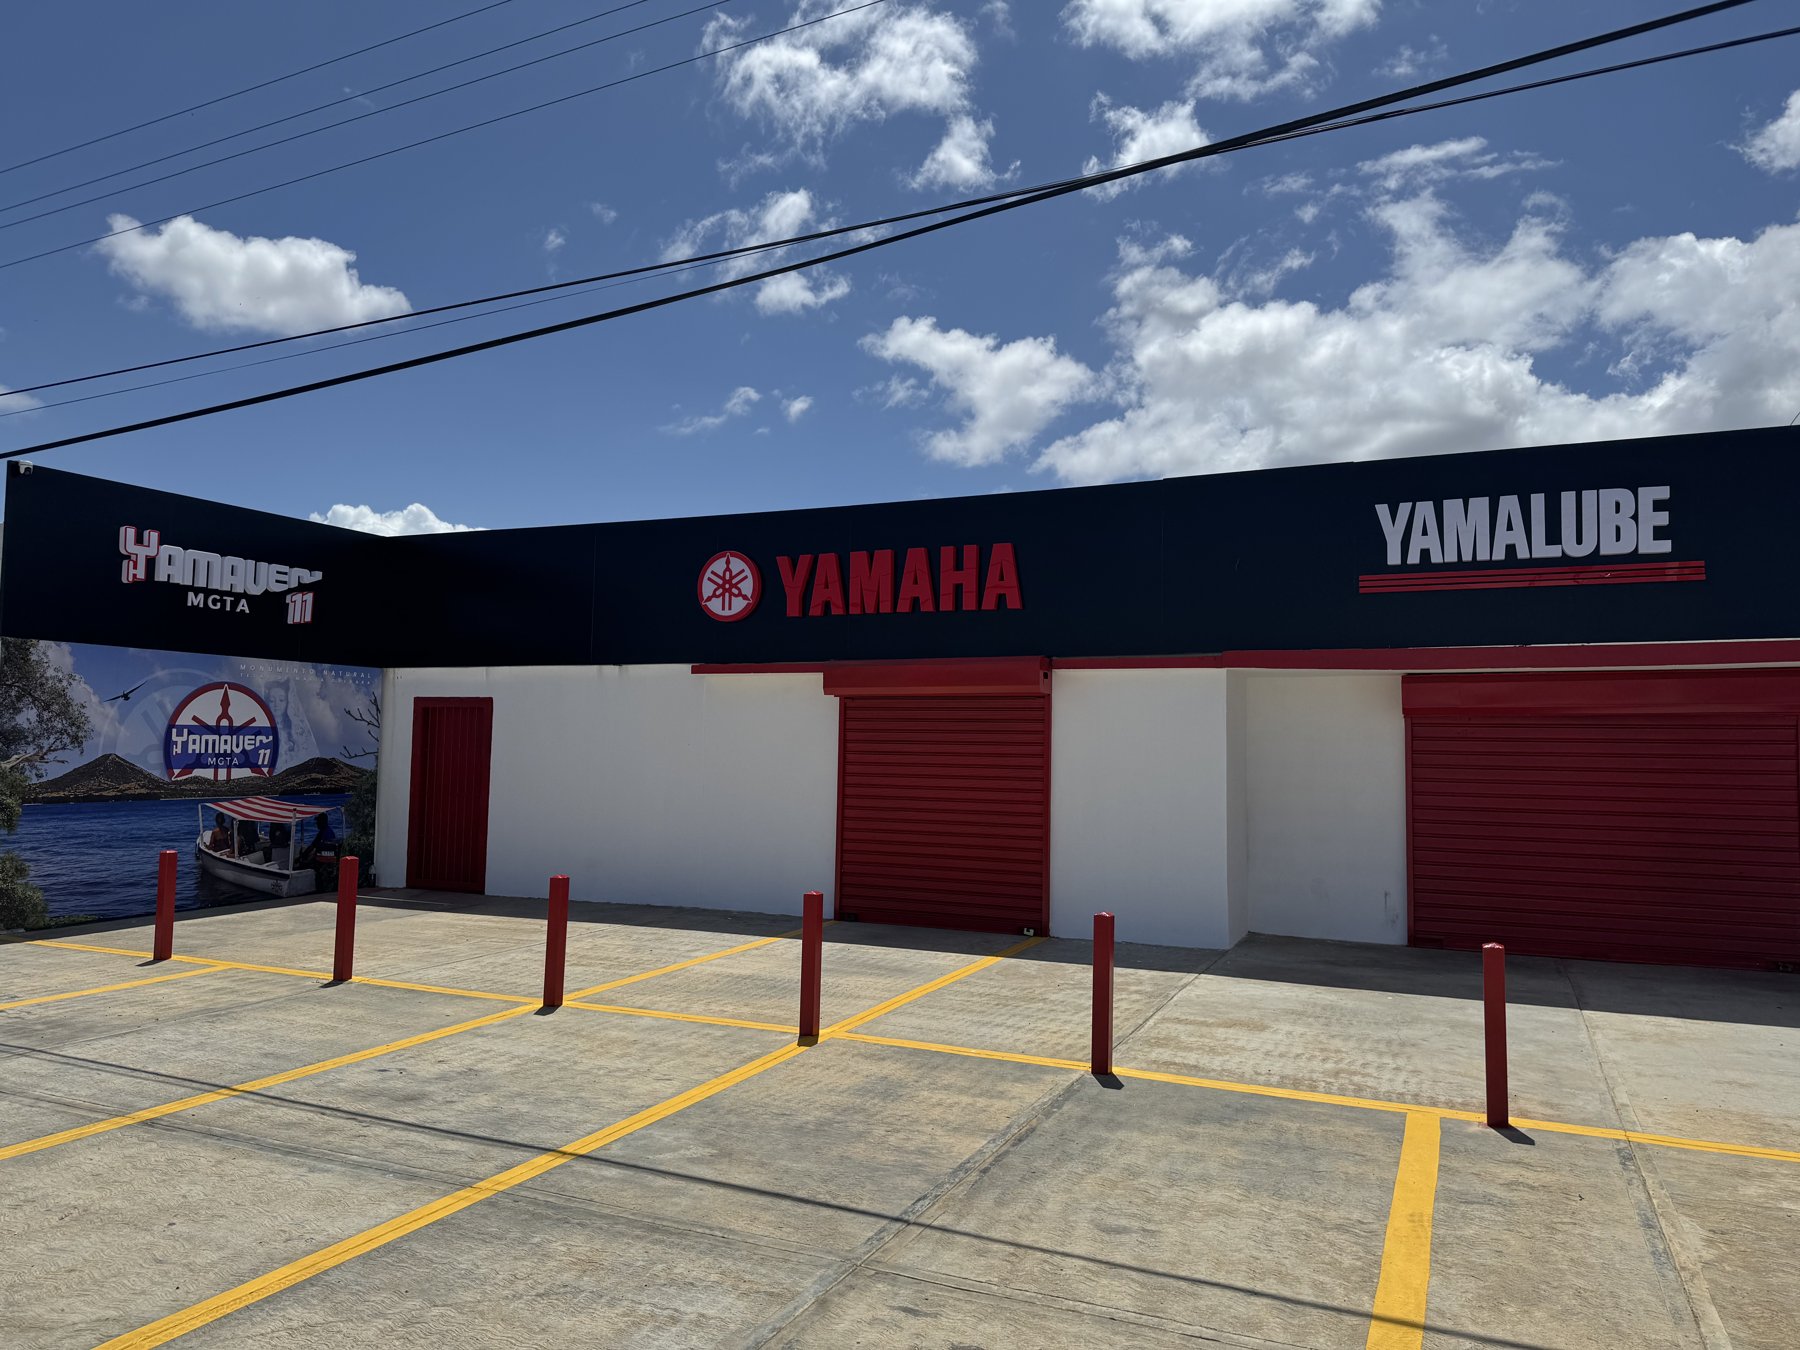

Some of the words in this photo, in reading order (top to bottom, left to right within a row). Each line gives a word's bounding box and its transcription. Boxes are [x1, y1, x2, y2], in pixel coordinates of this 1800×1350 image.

[1375, 485, 1672, 566] YAMALUBE
[775, 542, 1024, 617] YAMAHA
[187, 591, 250, 614] MGTA
[286, 591, 314, 624] 11
[323, 669, 371, 679] NATURAL
[207, 757, 240, 766] MGTA
[257, 748, 271, 766] 11
